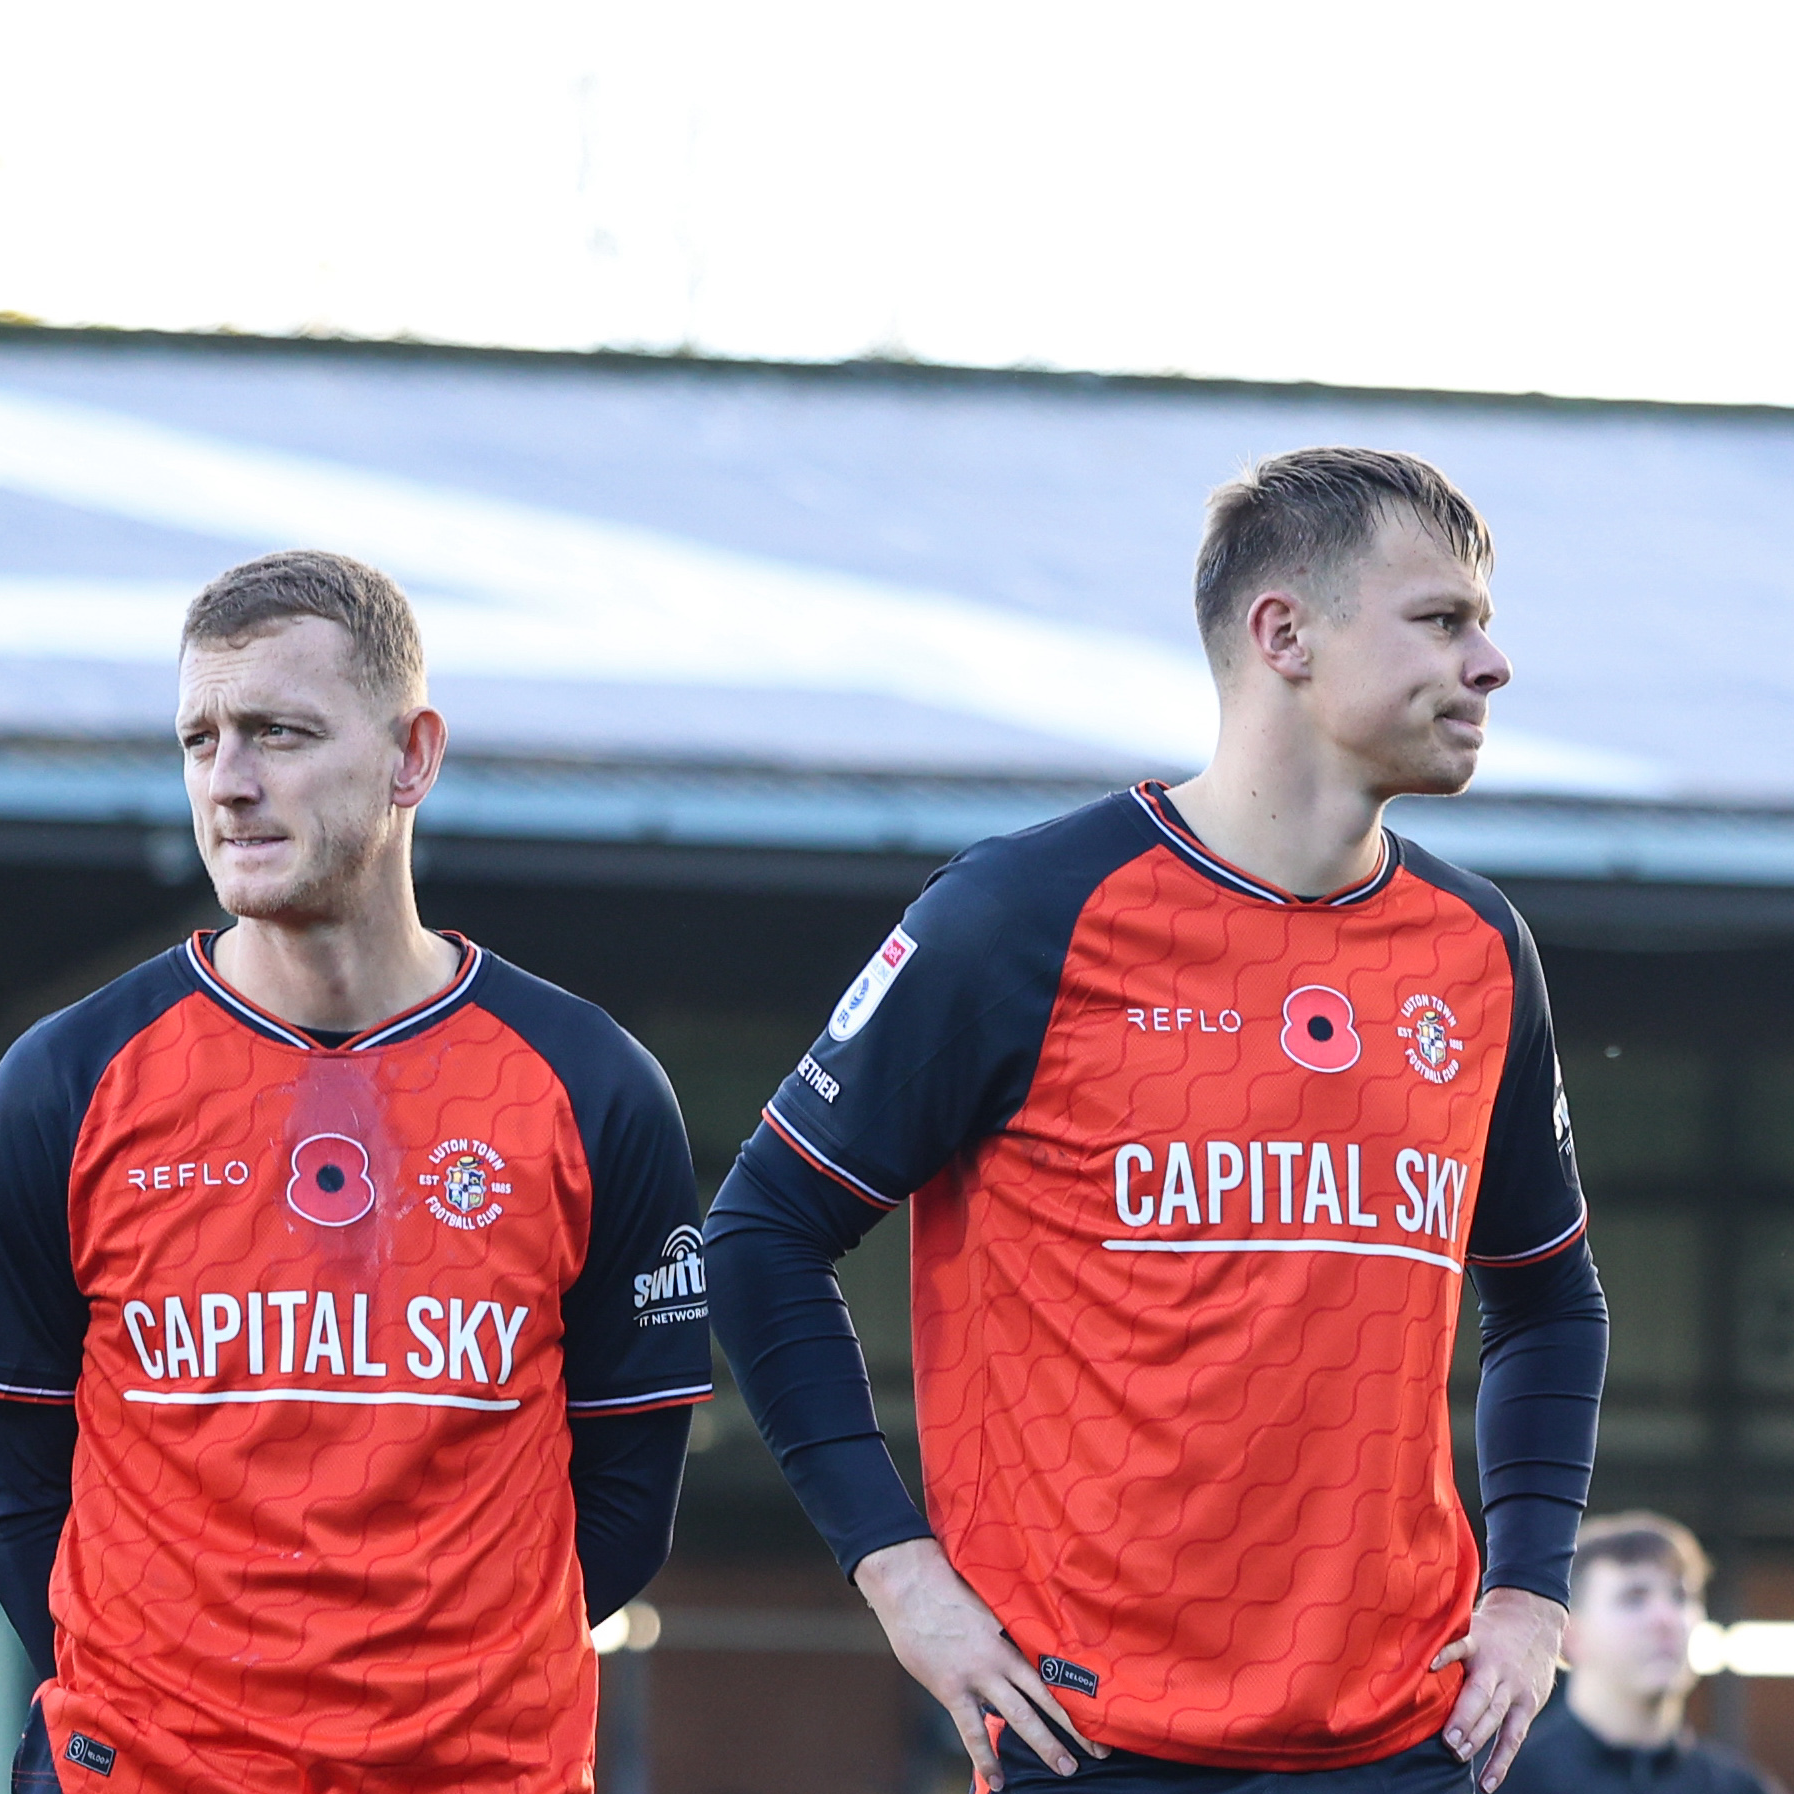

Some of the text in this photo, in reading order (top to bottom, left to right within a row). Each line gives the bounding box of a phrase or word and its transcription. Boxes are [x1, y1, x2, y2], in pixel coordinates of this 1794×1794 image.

[1127, 1008, 1242, 1033] REFLO
[1401, 993, 1457, 1028] LUTON TOWN
[796, 1053, 841, 1103] ETHER
[1442, 1059, 1459, 1083] CLUB
[428, 1138, 505, 1171] LUTON TOWN
[127, 1160, 249, 1191] REFLO
[418, 1174, 440, 1186] EST
[1113, 1141, 1469, 1243] CAPITAL SKY
[424, 1195, 503, 1230] FOOTBALL CLUB
[633, 1249, 707, 1309] swit
[122, 1289, 529, 1386] CAPITAL SKY
[639, 1315, 650, 1328] IT
